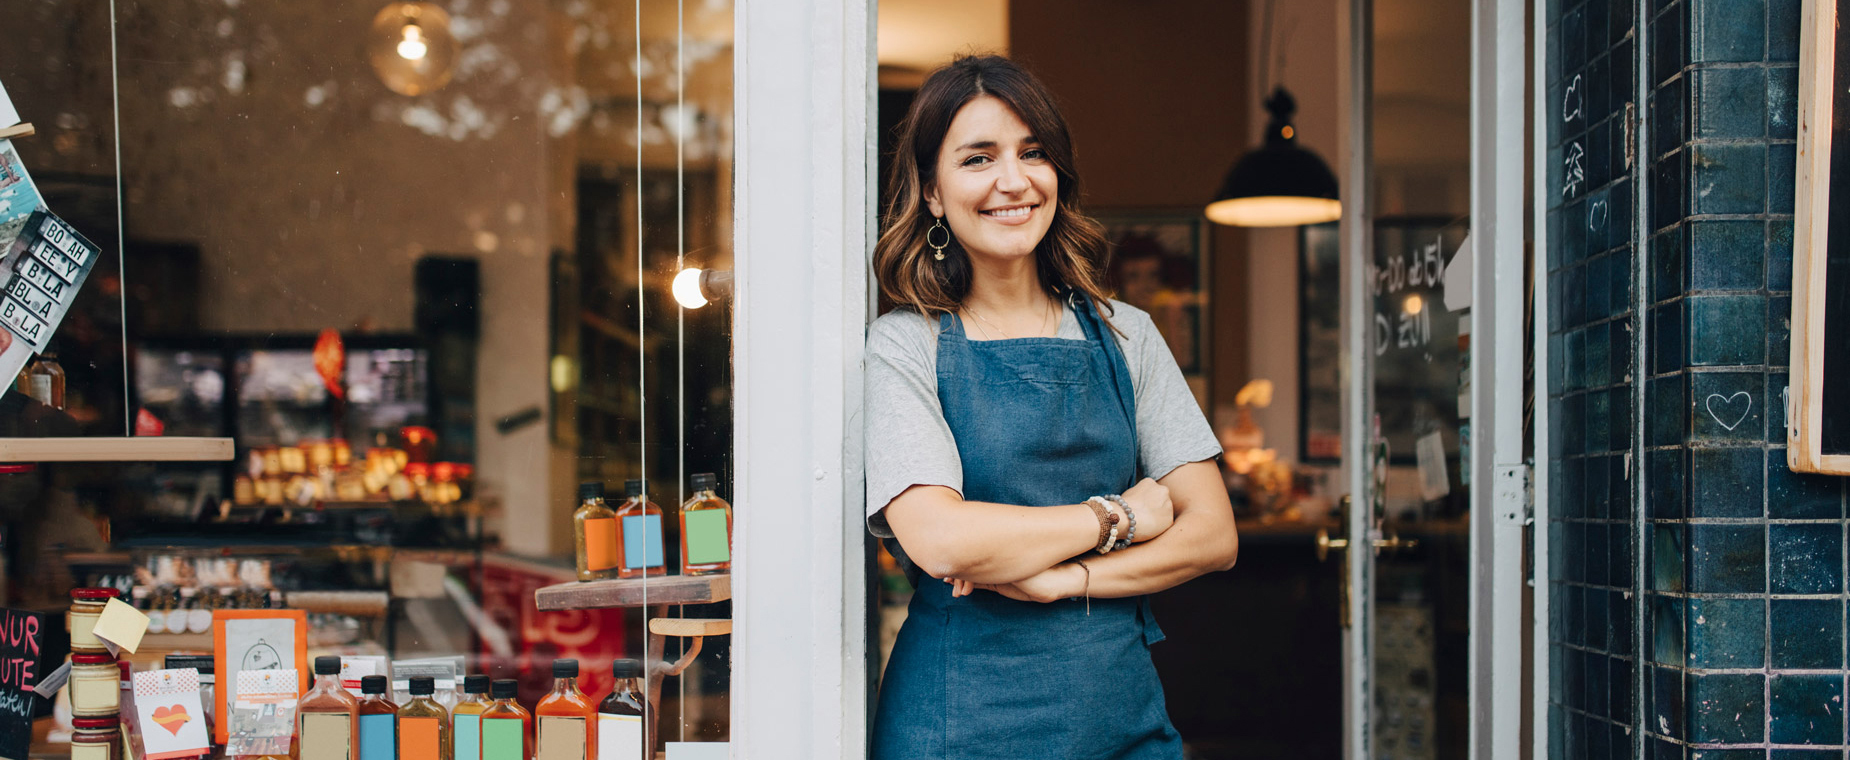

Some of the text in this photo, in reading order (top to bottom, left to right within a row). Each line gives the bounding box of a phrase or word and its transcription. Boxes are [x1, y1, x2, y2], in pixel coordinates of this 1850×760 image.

[46, 223, 85, 261] BO AH
[40, 244, 77, 278] EE Y
[27, 263, 64, 299] B LA
[14, 282, 52, 318] BL A
[3, 302, 41, 339] B LA
